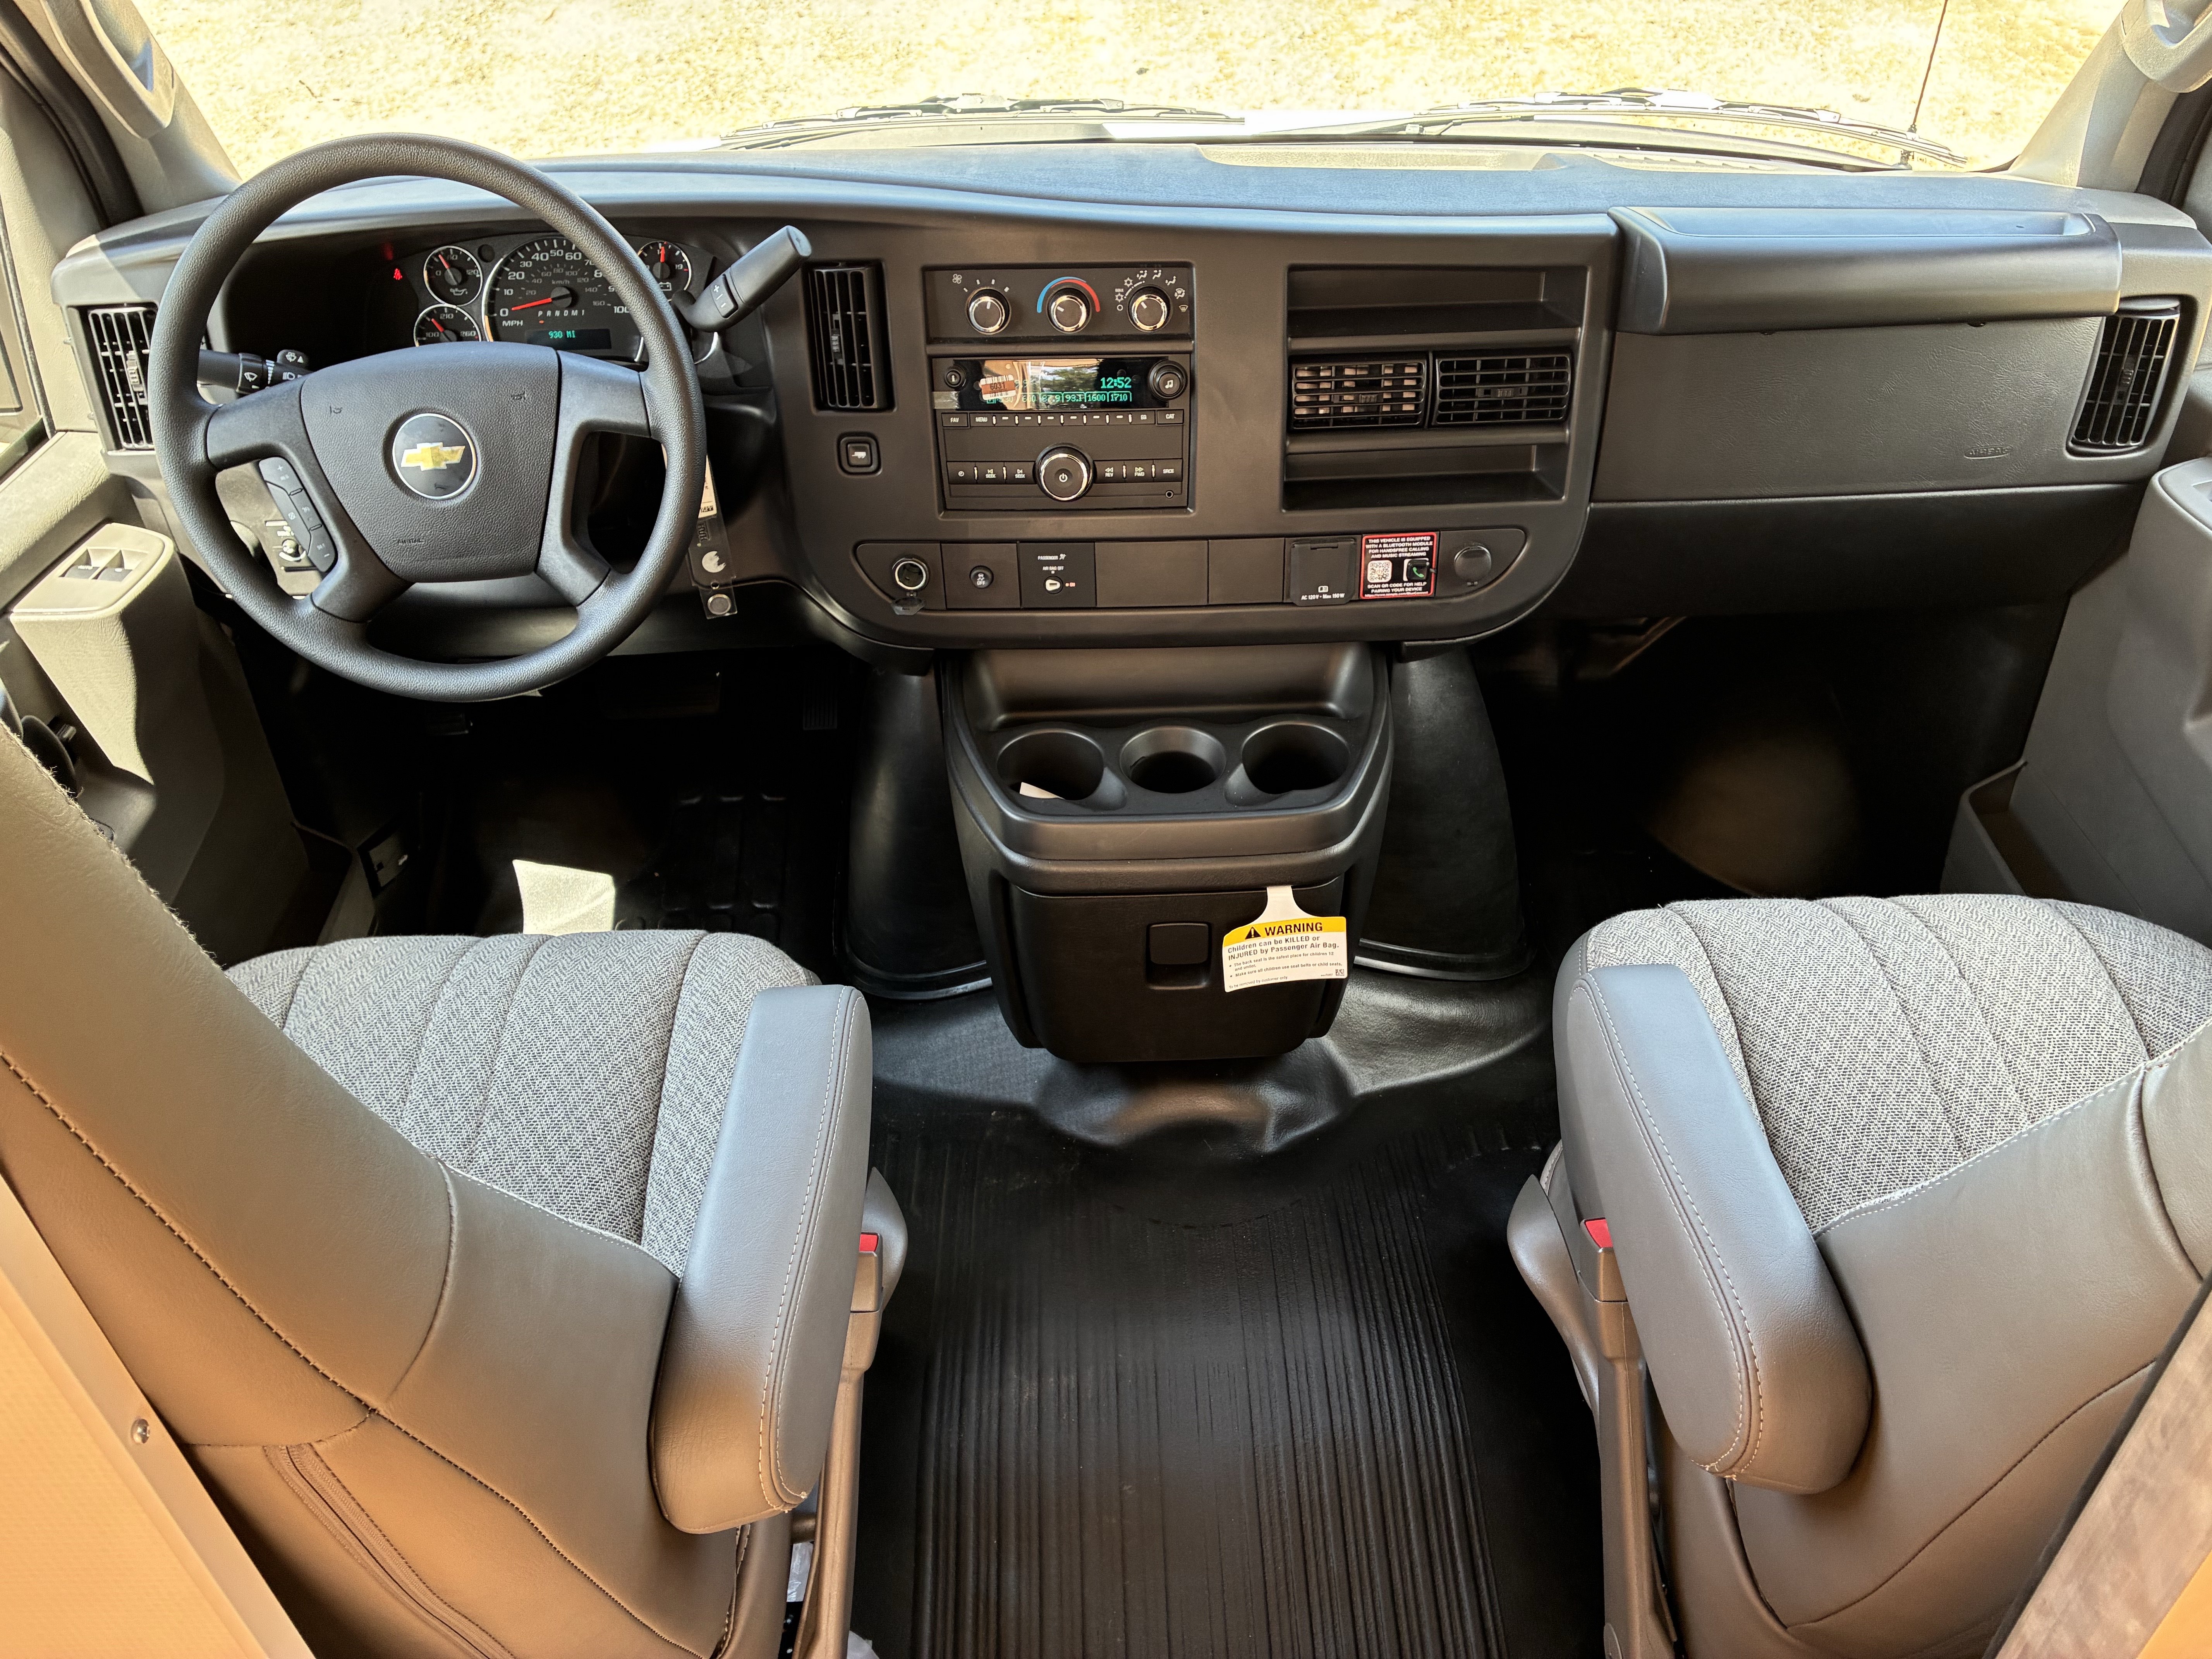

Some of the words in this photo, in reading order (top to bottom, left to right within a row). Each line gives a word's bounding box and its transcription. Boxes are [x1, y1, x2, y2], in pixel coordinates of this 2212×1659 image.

[531, 252, 549, 261] 40
[565, 252, 582, 260] 60
[508, 271, 525, 280] 20
[594, 270, 602, 278] 8
[500, 308, 508, 316] 0
[548, 331, 563, 339] 930
[1101, 377, 1132, 388] 12:52
[1111, 393, 1128, 402] 1710
[1265, 922, 1322, 936] WARNING
[1228, 943, 1256, 953] Children
[1228, 949, 1257, 960] INJURED
[1271, 944, 1308, 952] Passenger
